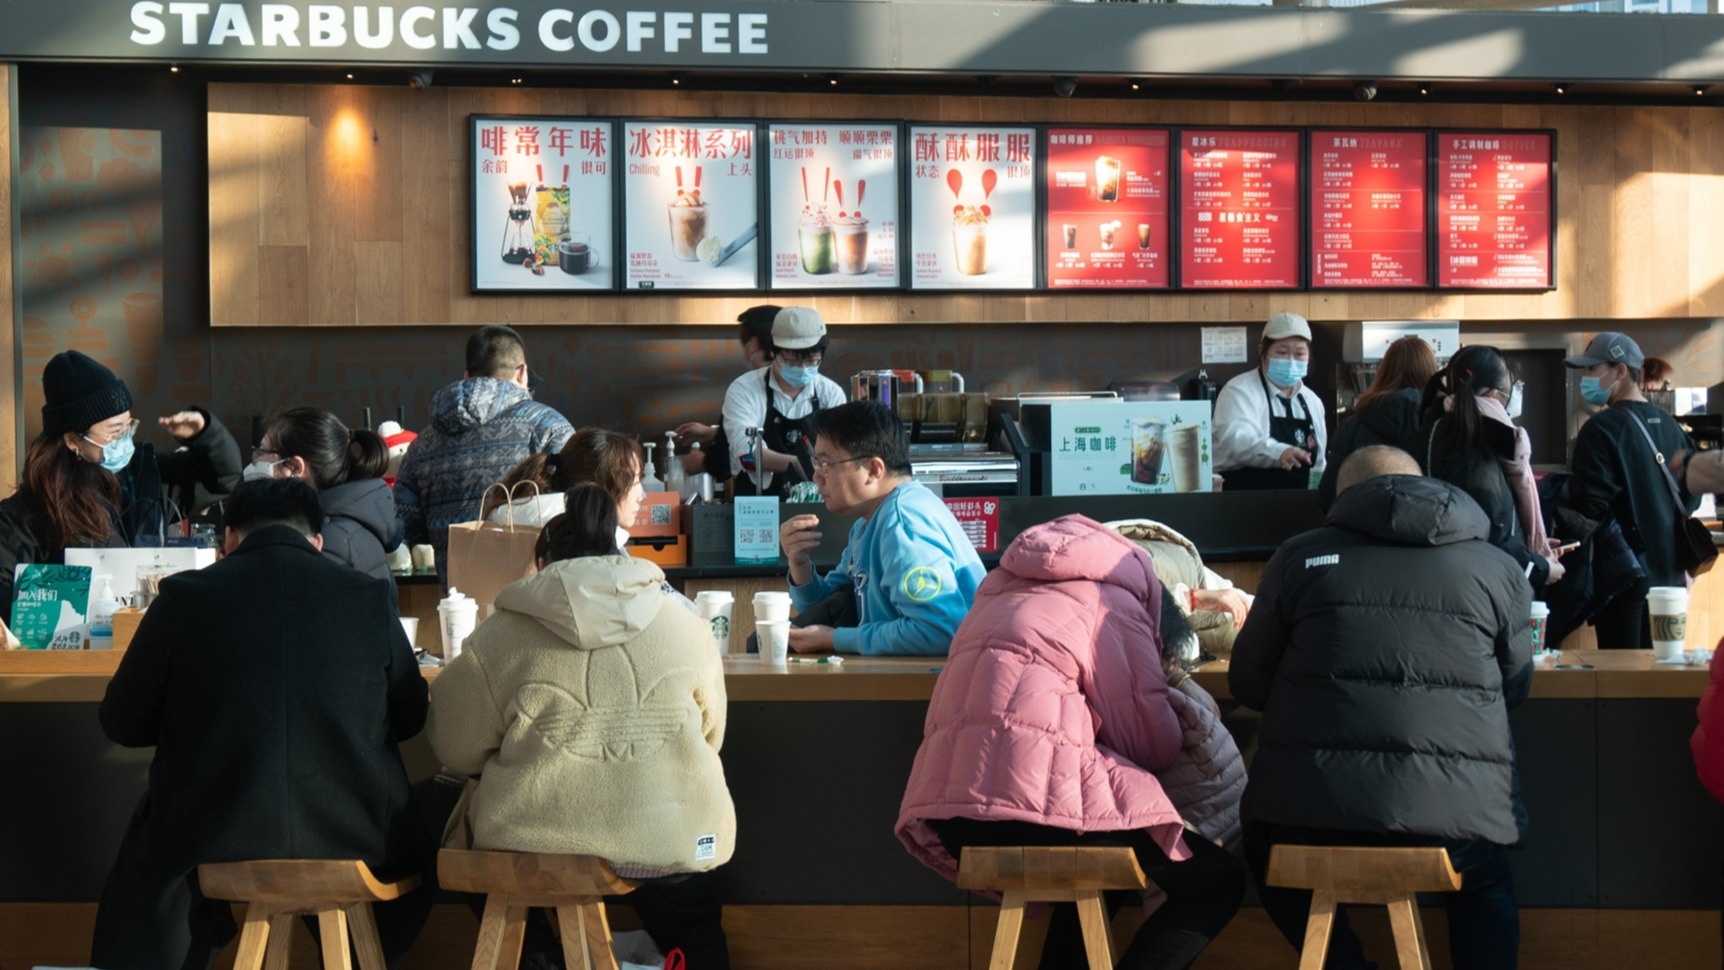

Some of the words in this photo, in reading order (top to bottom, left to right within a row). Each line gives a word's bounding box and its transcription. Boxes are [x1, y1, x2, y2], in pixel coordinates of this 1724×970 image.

[129, 1, 520, 51] STARBUCKS
[537, 8, 768, 54] COFFEE
[481, 127, 606, 157] 啡常年味
[629, 129, 752, 159] 冰淇淋系列
[773, 129, 828, 145] 桃气加持
[838, 130, 893, 145] 顺顺栗栗
[1050, 134, 1093, 145] 咖啡师推荐
[1191, 136, 1216, 147] 星冰乐
[1333, 137, 1358, 148] 茶瓦纳
[1452, 139, 1500, 150] 手工调制咖啡
[915, 132, 1031, 162] 酥酥服服
[481, 159, 508, 174] 余韵
[581, 160, 607, 175] 很可
[629, 163, 661, 178] Chilling
[727, 162, 752, 177] 上头
[915, 165, 940, 179] 状态
[1059, 436, 1117, 452] 上海咖啡
[1305, 554, 1339, 568] PUMA
[17, 588, 58, 602] 加入我们
